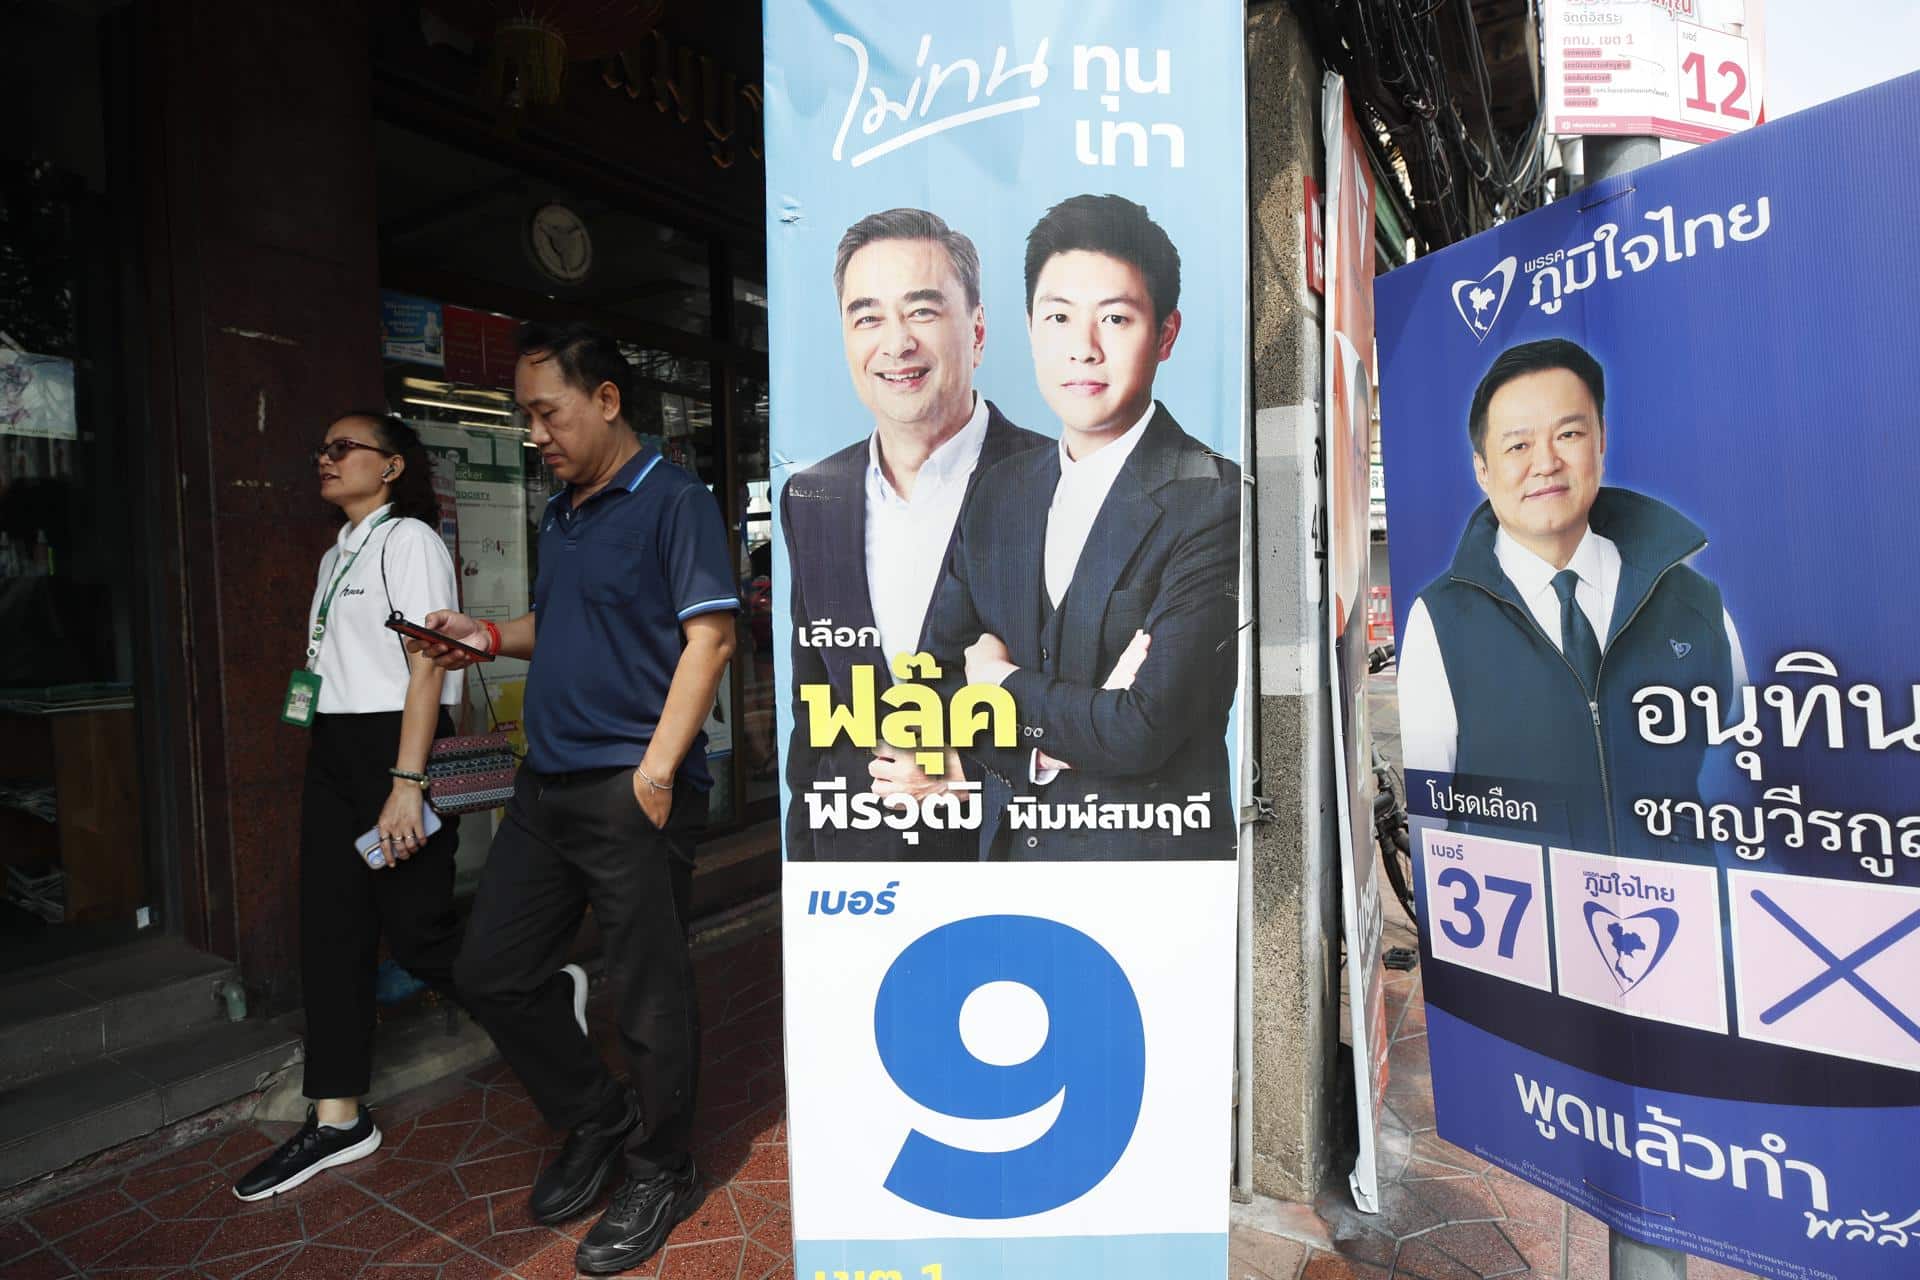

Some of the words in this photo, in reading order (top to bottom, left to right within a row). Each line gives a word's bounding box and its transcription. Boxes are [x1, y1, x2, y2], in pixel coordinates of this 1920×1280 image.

[1599, 34, 1621, 45] เขต
[1625, 34, 1635, 45] 1
[832, 33, 1048, 161] ไม่ทน
[1072, 44, 1171, 112] ทุน
[1682, 51, 1750, 120] 12
[1075, 119, 1185, 168] เทา
[1524, 249, 1564, 274] พรรค
[1529, 197, 1770, 315] ภูมิใจไทย
[799, 618, 881, 648] เลือก
[1632, 651, 1920, 781] อนุทิน
[804, 776, 983, 845] พีรวุฒิ
[1007, 792, 1211, 836] พิมพ์สมฤดี
[1425, 779, 1537, 823] โปรดเลือก
[1431, 843, 1465, 862] เบอร์
[807, 881, 900, 916] เบอร์
[1439, 867, 1532, 959] 37
[1585, 872, 1675, 903] ภูมิใจไทย
[874, 914, 1146, 1220] 9
[1513, 1073, 1829, 1212] พูดแล้วทำ
